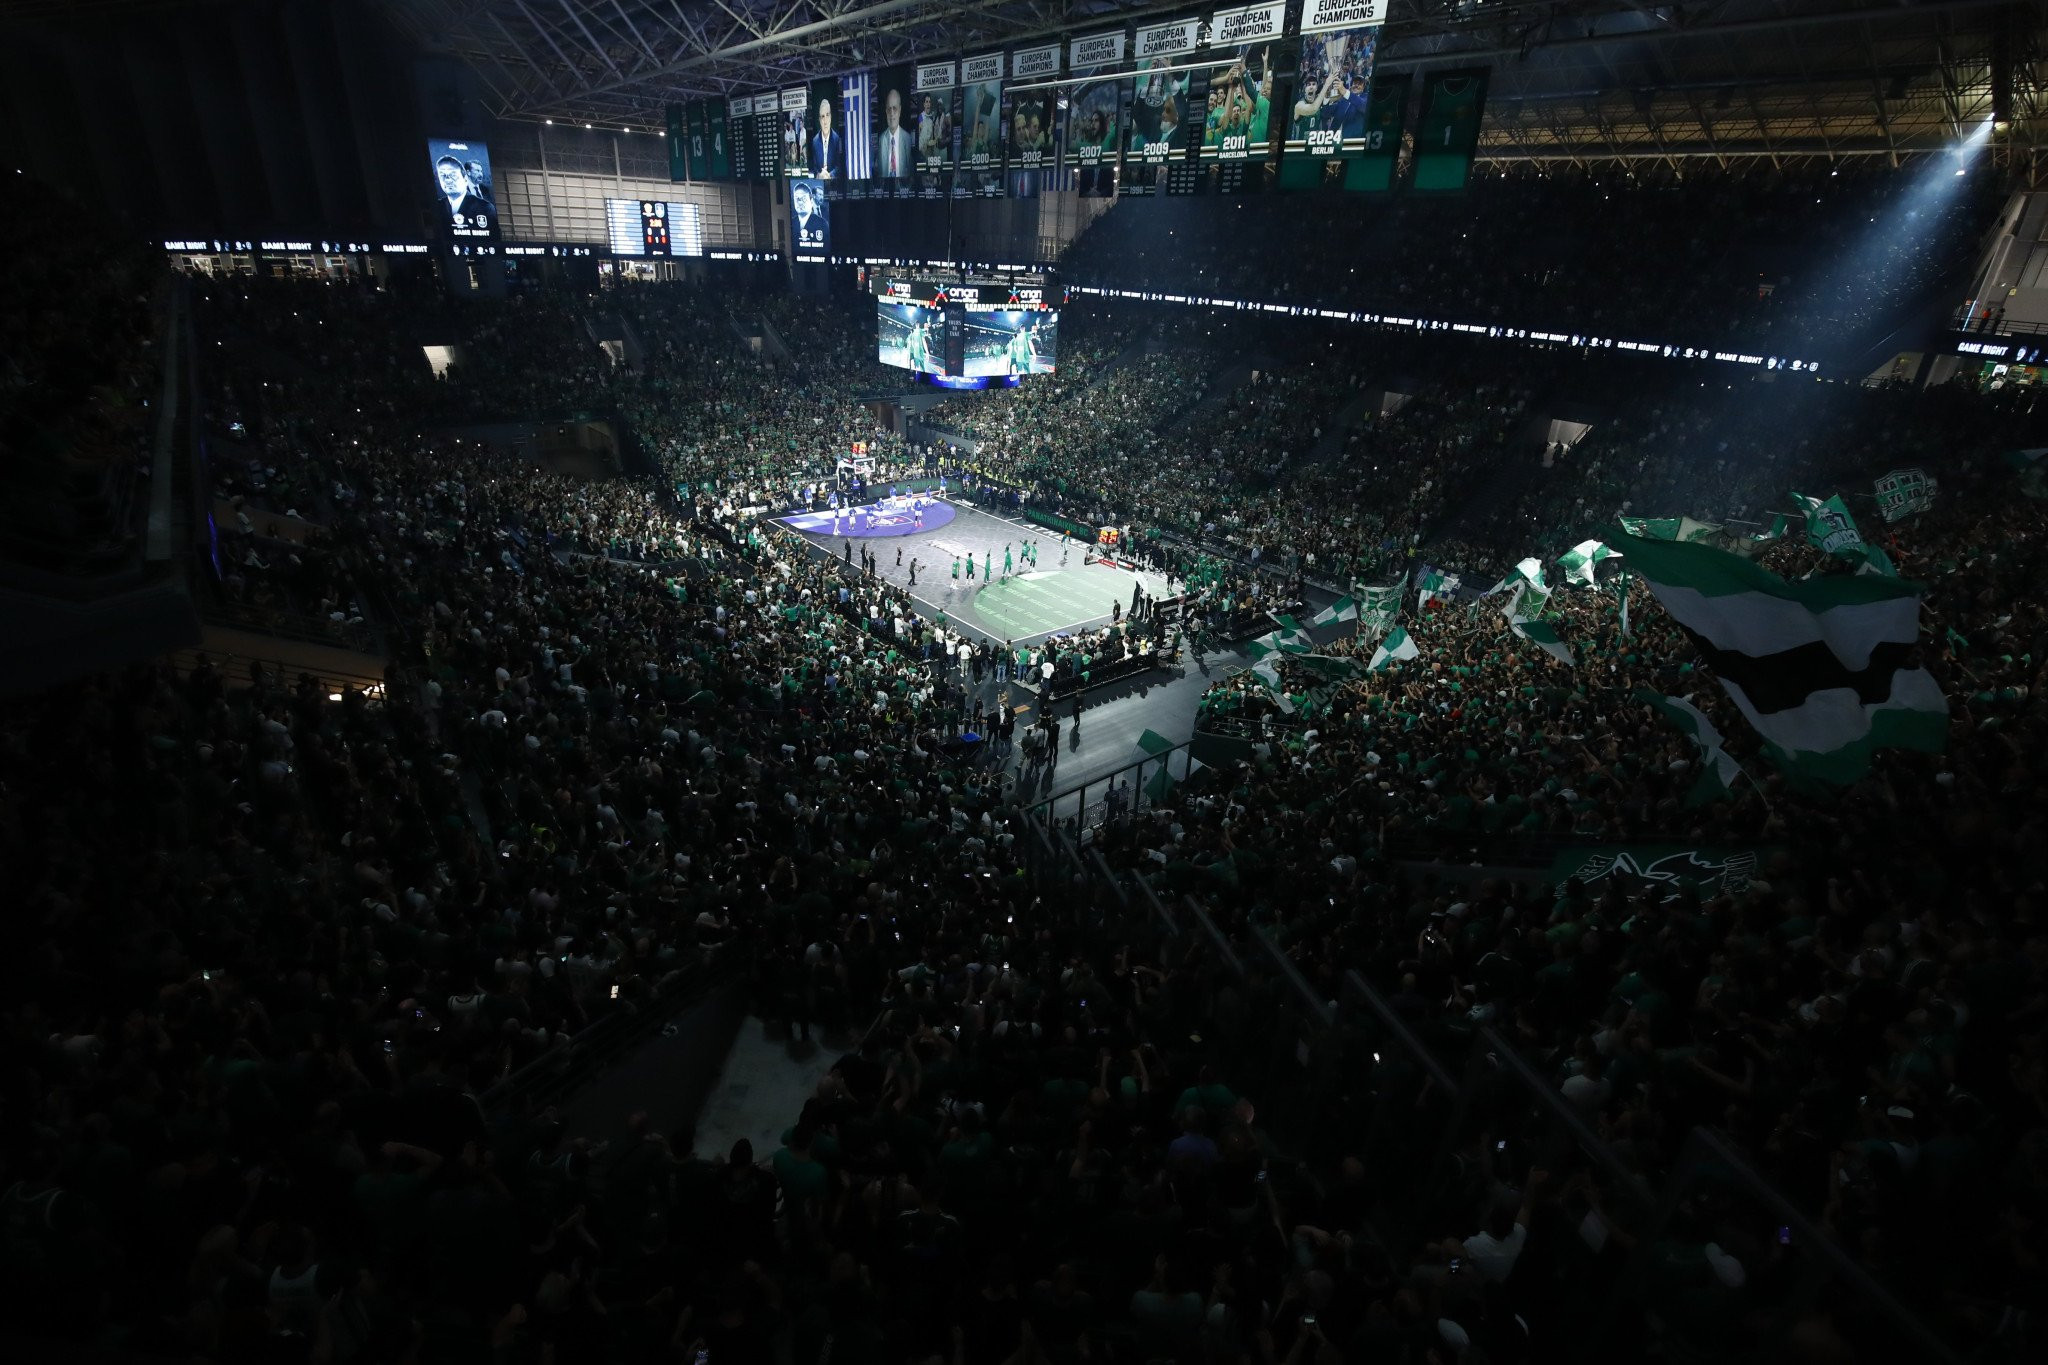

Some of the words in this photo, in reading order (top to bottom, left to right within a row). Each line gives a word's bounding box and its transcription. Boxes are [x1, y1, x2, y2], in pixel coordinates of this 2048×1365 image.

[1224, 10, 1270, 28] EUROPEAN
[1313, 6, 1375, 25] CHAMPIONS
[1147, 27, 1185, 43] EUROPEAN
[1220, 22, 1272, 40] CHAMPIONS
[1080, 38, 1114, 53] EUROPEAN
[1143, 38, 1187, 54] CHAMPIONS
[1022, 51, 1052, 64] EUROPEAN
[1077, 48, 1116, 63] CHAMPIONS
[969, 59, 997, 71] EUROPEAN
[1018, 61, 1053, 74] CHAMPIONS
[924, 67, 948, 78] EUROPEAN
[967, 68, 998, 80] CHAMPIONS
[922, 76, 950, 86] CHAMPIONS
[1308, 128, 1342, 146] 2024
[1366, 131, 1384, 150] 13
[1444, 125, 1452, 146] 1
[692, 135, 702, 157] 13
[714, 133, 722, 155] 4
[1144, 142, 1169, 156] 2009
[1223, 136, 1246, 150] 2011
[1312, 146, 1334, 154] BERLIN
[972, 153, 989, 164] 2000
[1022, 151, 1042, 162] 2002
[1080, 146, 1102, 158] 2007
[1218, 151, 1248, 159] BARCELONA
[928, 156, 941, 166] 1996
[1617, 341, 1637, 350] GAME
[1637, 343, 1660, 353] NIGHT
[1957, 341, 1982, 353] GAME
[1981, 344, 2009, 356] NIGHT
[1715, 352, 1738, 362] GAME
[1738, 354, 1763, 365] NIGHT
[1027, 509, 1077, 533] PANATHINAIKOS
[1079, 527, 1088, 537] BC
[1098, 535, 1107, 543] 24
[1108, 535, 1118, 543] 24
